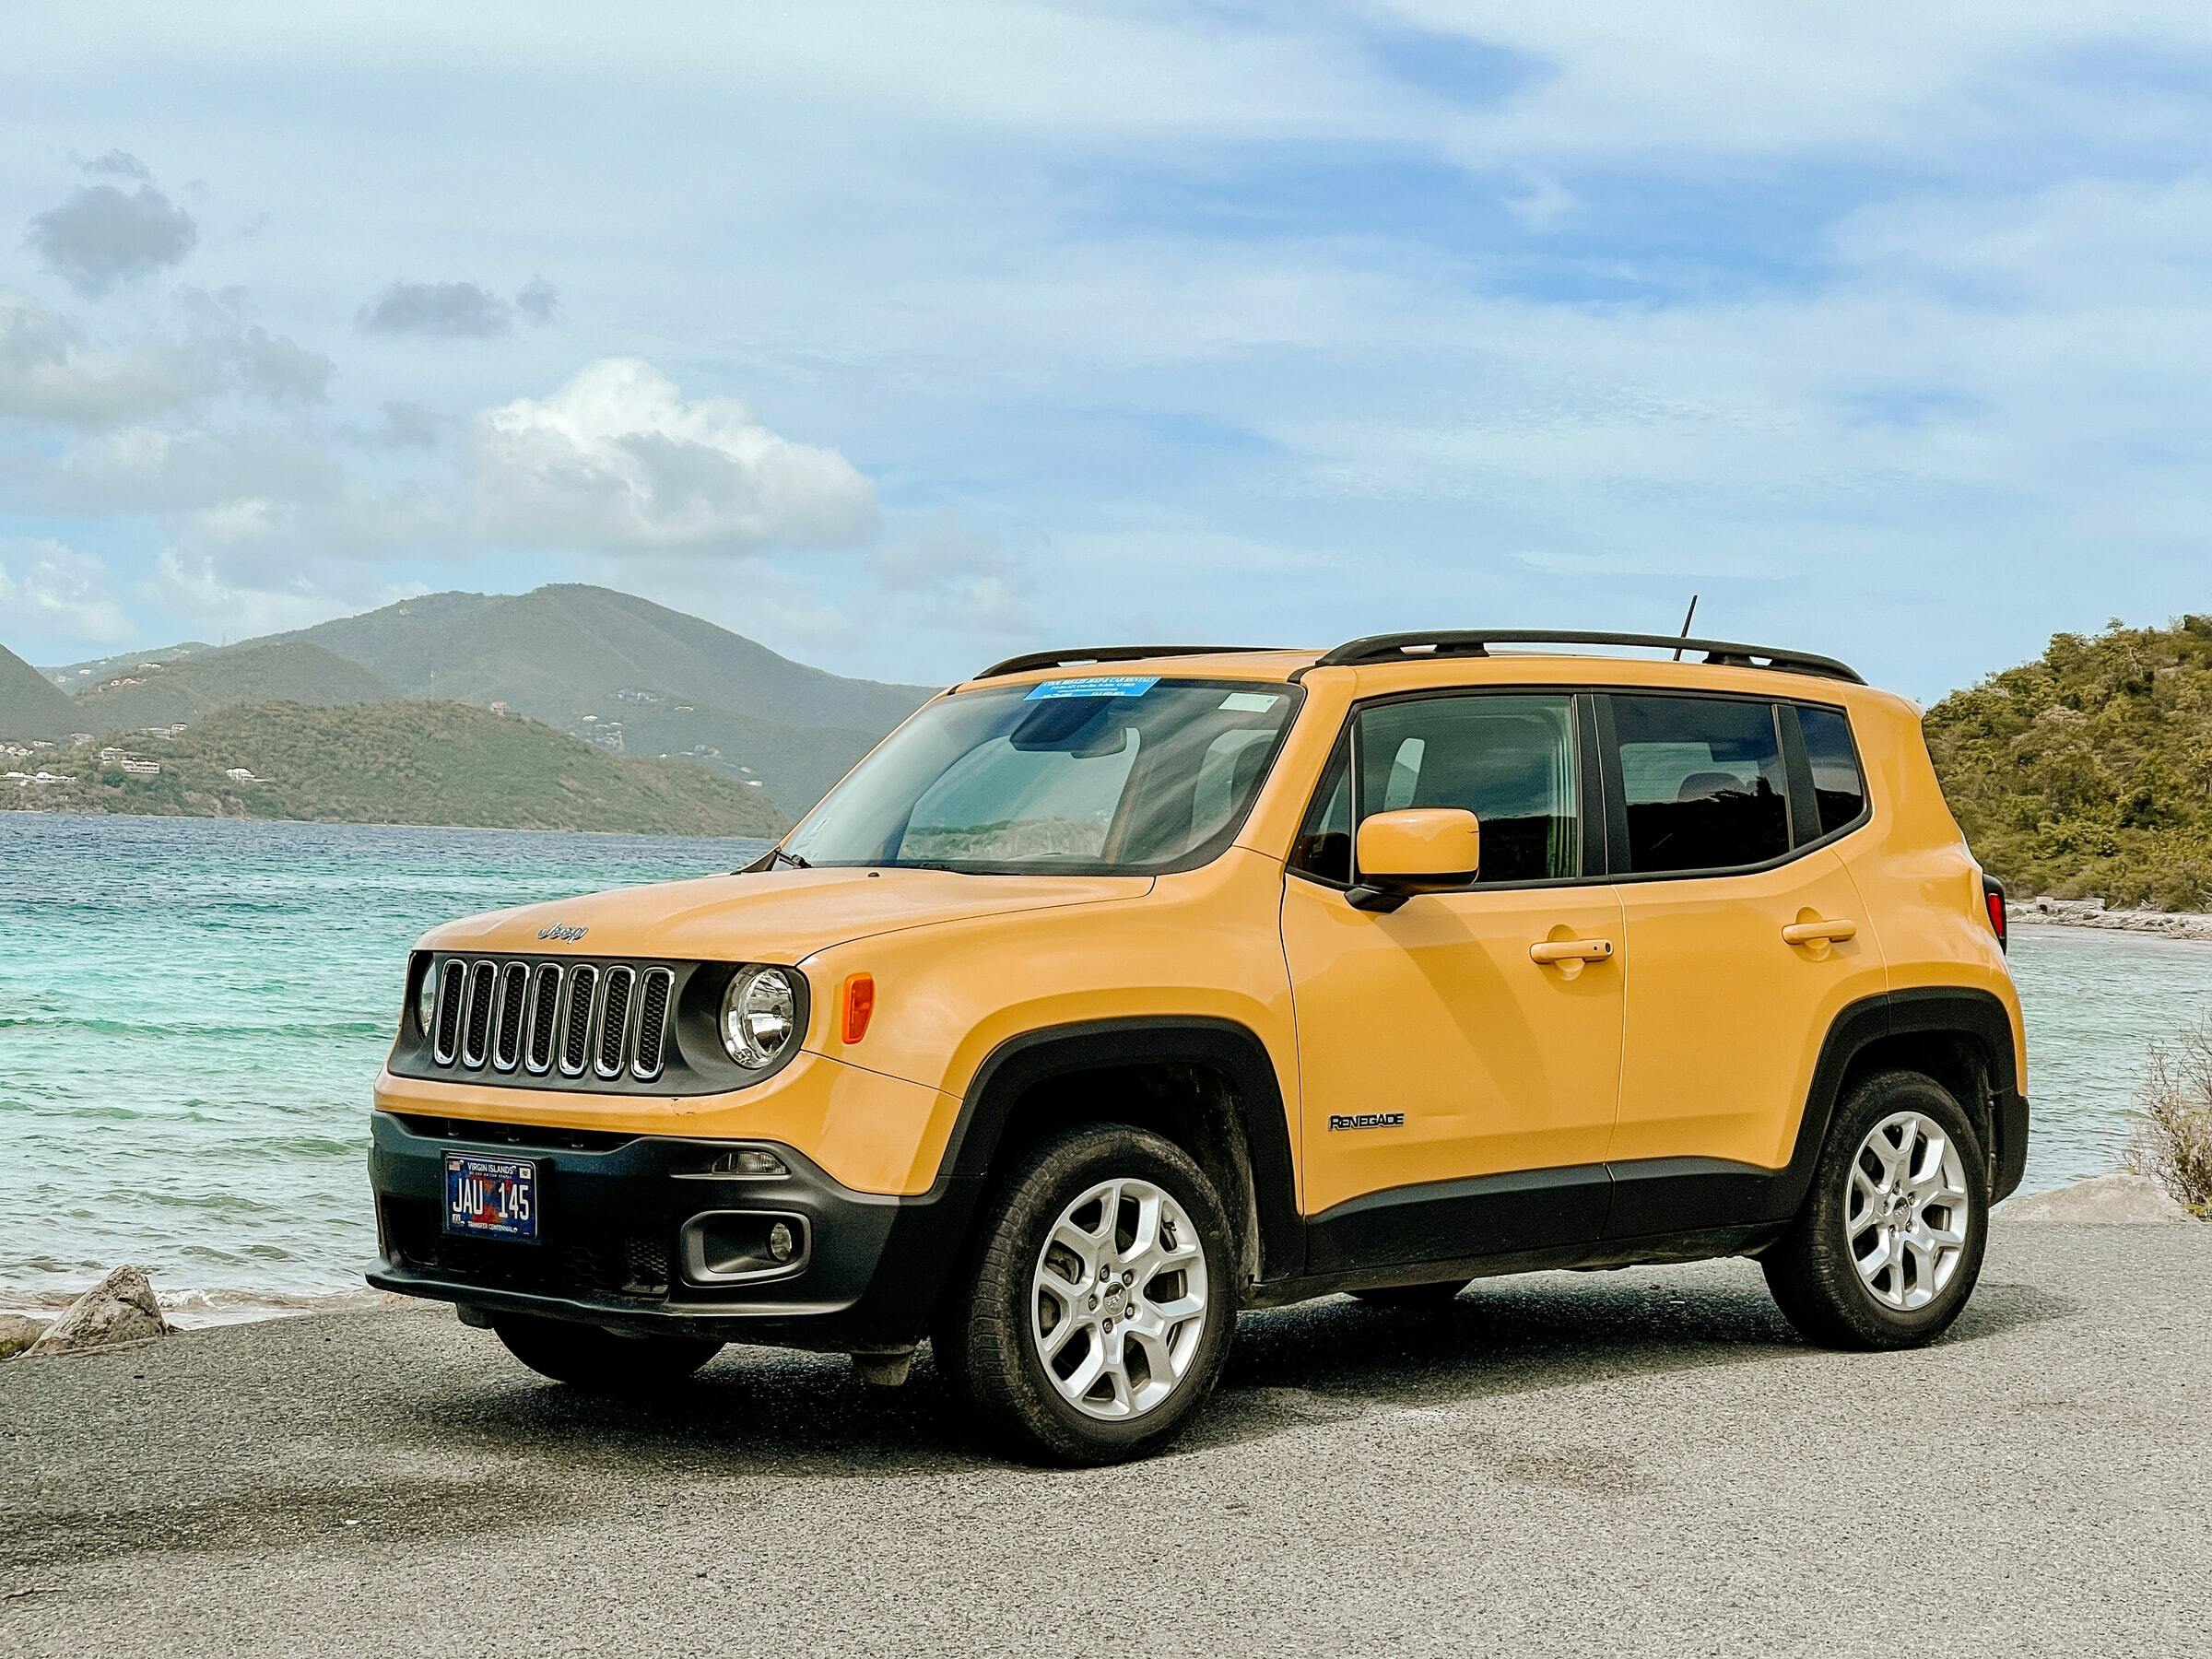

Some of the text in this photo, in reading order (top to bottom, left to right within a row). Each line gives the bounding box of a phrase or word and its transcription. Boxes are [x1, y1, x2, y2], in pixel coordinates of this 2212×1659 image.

[538, 922, 589, 944] Jeep
[1328, 1112, 1405, 1131] RENEGADE
[467, 1161, 513, 1174] VIRGIN ISLANDS
[453, 1178, 529, 1221] JAU 145
